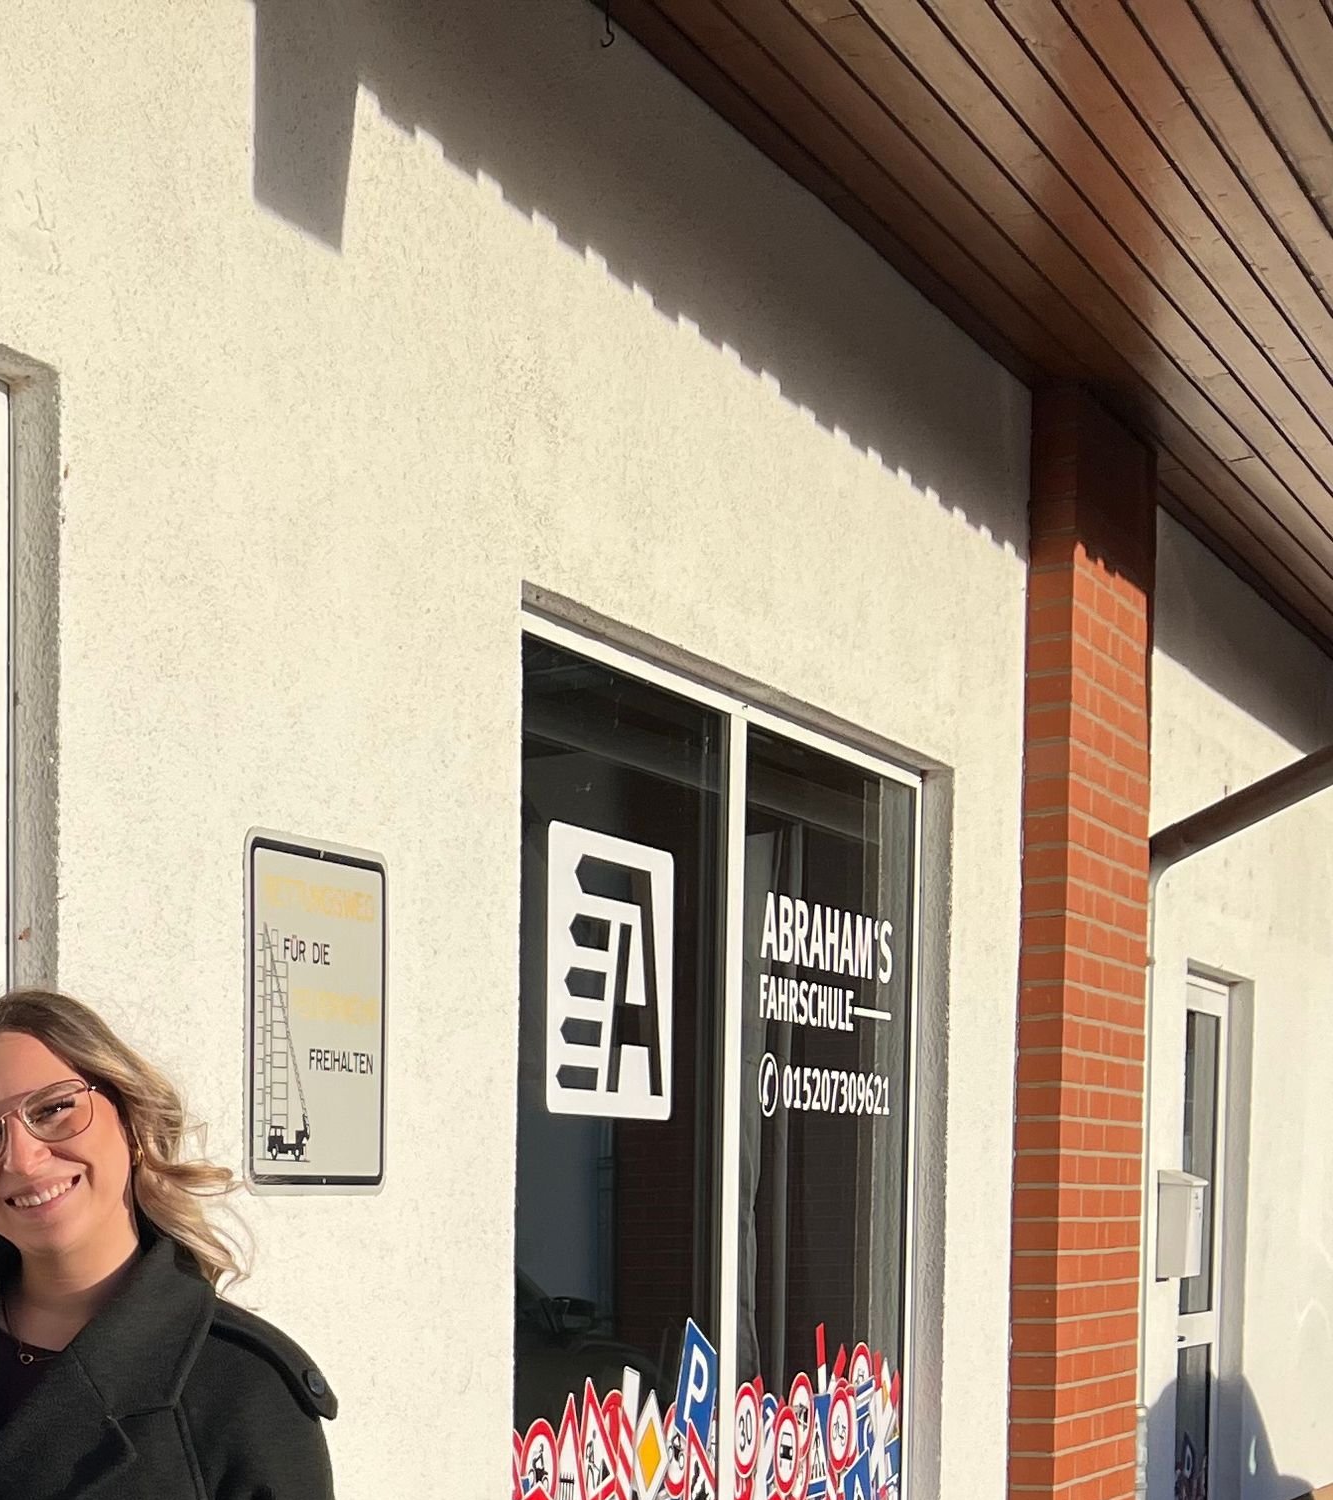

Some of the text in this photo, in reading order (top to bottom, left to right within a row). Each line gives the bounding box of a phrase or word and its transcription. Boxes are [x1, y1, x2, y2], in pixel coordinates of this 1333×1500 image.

[283, 934, 331, 965] FÜR DIE
[760, 891, 893, 984] ABRAHAM'S
[759, 974, 854, 1032] FAHRSCHULE
[308, 1048, 374, 1075] FREIHALTEN
[783, 1064, 890, 1116] 015207309621
[683, 1344, 708, 1423] P
[738, 1409, 753, 1453] 30
